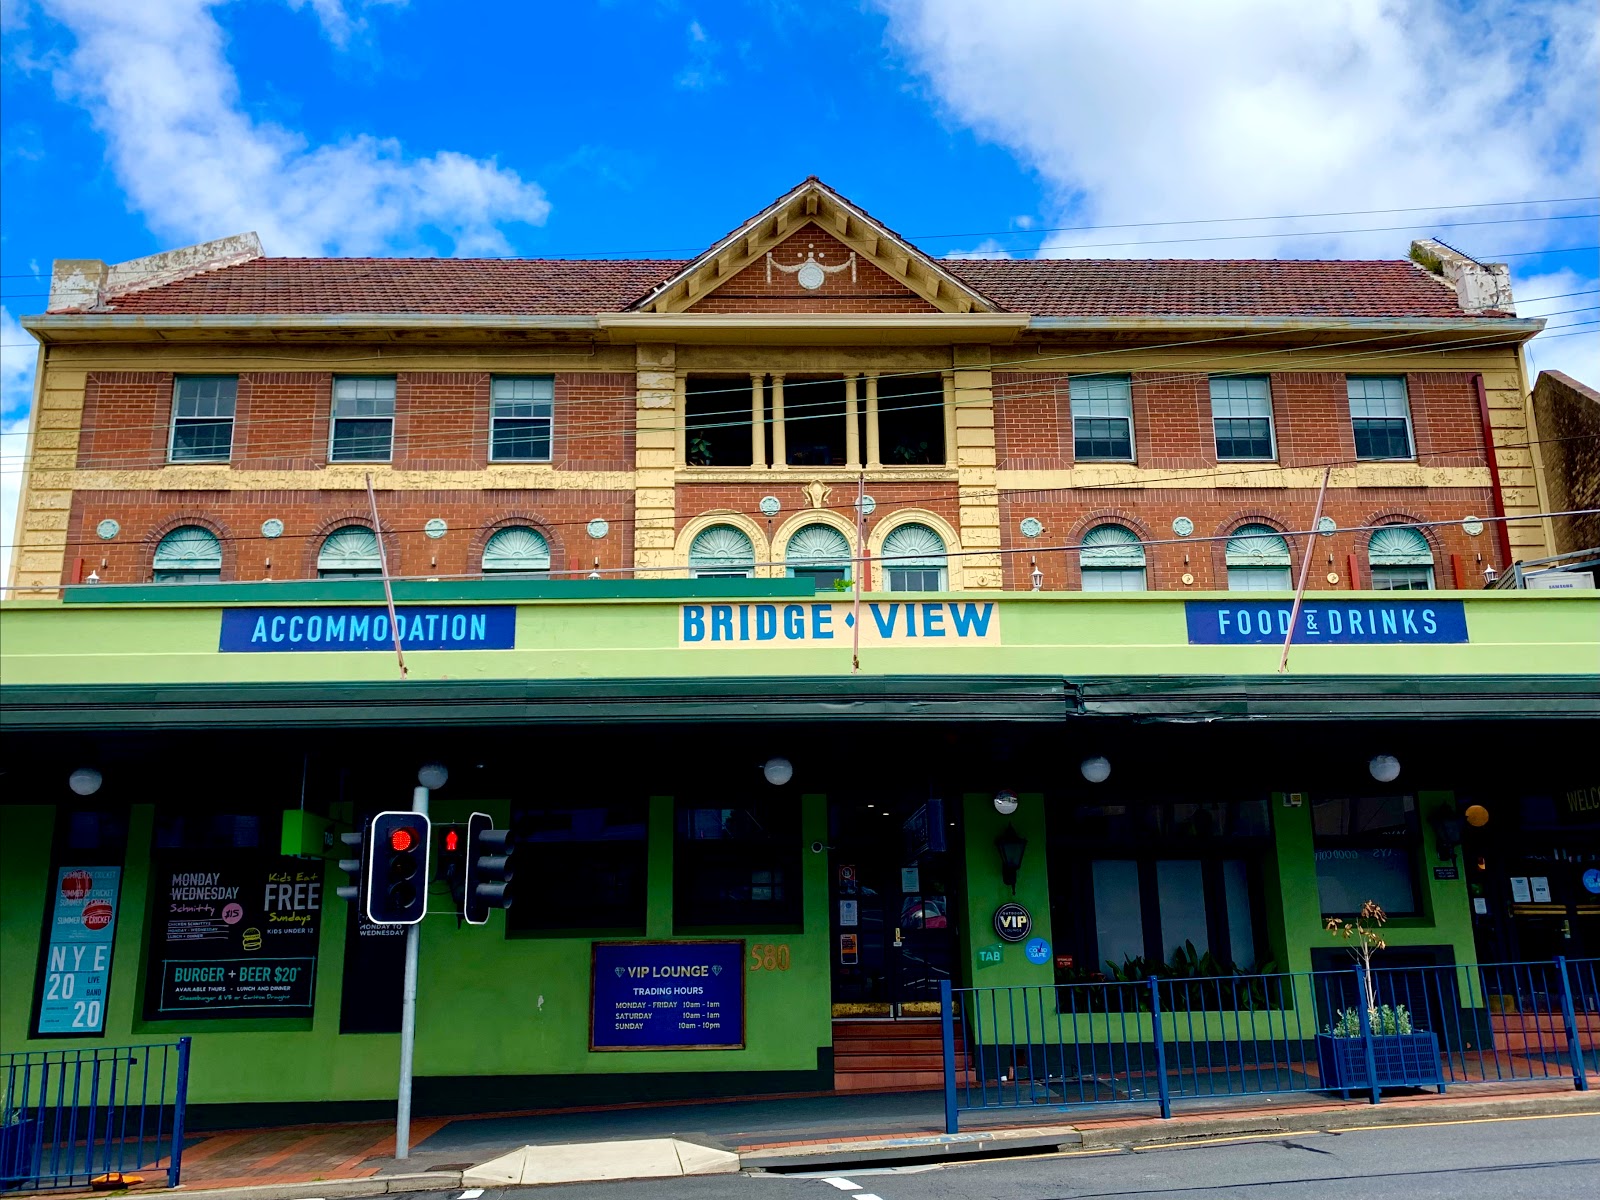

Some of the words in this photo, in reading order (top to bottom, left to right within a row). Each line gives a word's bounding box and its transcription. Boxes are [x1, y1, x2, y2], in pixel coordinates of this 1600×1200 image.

[251, 614, 486, 642] ACCOMMODATION
[682, 604, 834, 642] BRIDGE
[869, 602, 994, 639] VIEW
[1218, 609, 1291, 635] FOOD
[1306, 613, 1319, 631] &
[1328, 609, 1437, 635] DRINKS
[1567, 786, 1600, 813] WELC
[172, 873, 220, 886] MONDAY
[269, 872, 291, 882] Kids
[296, 872, 318, 881] Eat
[60, 889, 84, 897] SUMMER
[92, 889, 114, 897] CRICKET
[171, 886, 240, 901] WEDNESDAY
[264, 882, 320, 912] FREE
[170, 903, 215, 917] Schnitty
[224, 909, 239, 919] $15
[57, 916, 81, 924] SUMMER
[89, 915, 111, 924] CRICKET
[268, 911, 311, 926] Sundays
[999, 915, 1027, 928] VIP
[750, 944, 790, 971] 580
[979, 951, 1000, 961] TAB
[174, 967, 225, 982] BURGER
[239, 967, 271, 982] BEER
[627, 966, 649, 978] VIP
[652, 965, 709, 978] LOUNGE
[47, 973, 75, 1000] 20
[88, 976, 100, 984] LIVE
[86, 988, 102, 996] BAND
[633, 987, 672, 995] TRADING
[674, 986, 704, 995] HOURS
[72, 1001, 100, 1027] 20
[615, 1012, 652, 1020] SATURDAY
[615, 1022, 644, 1030] SUNDAY
[702, 1022, 720, 1030] 10pm
